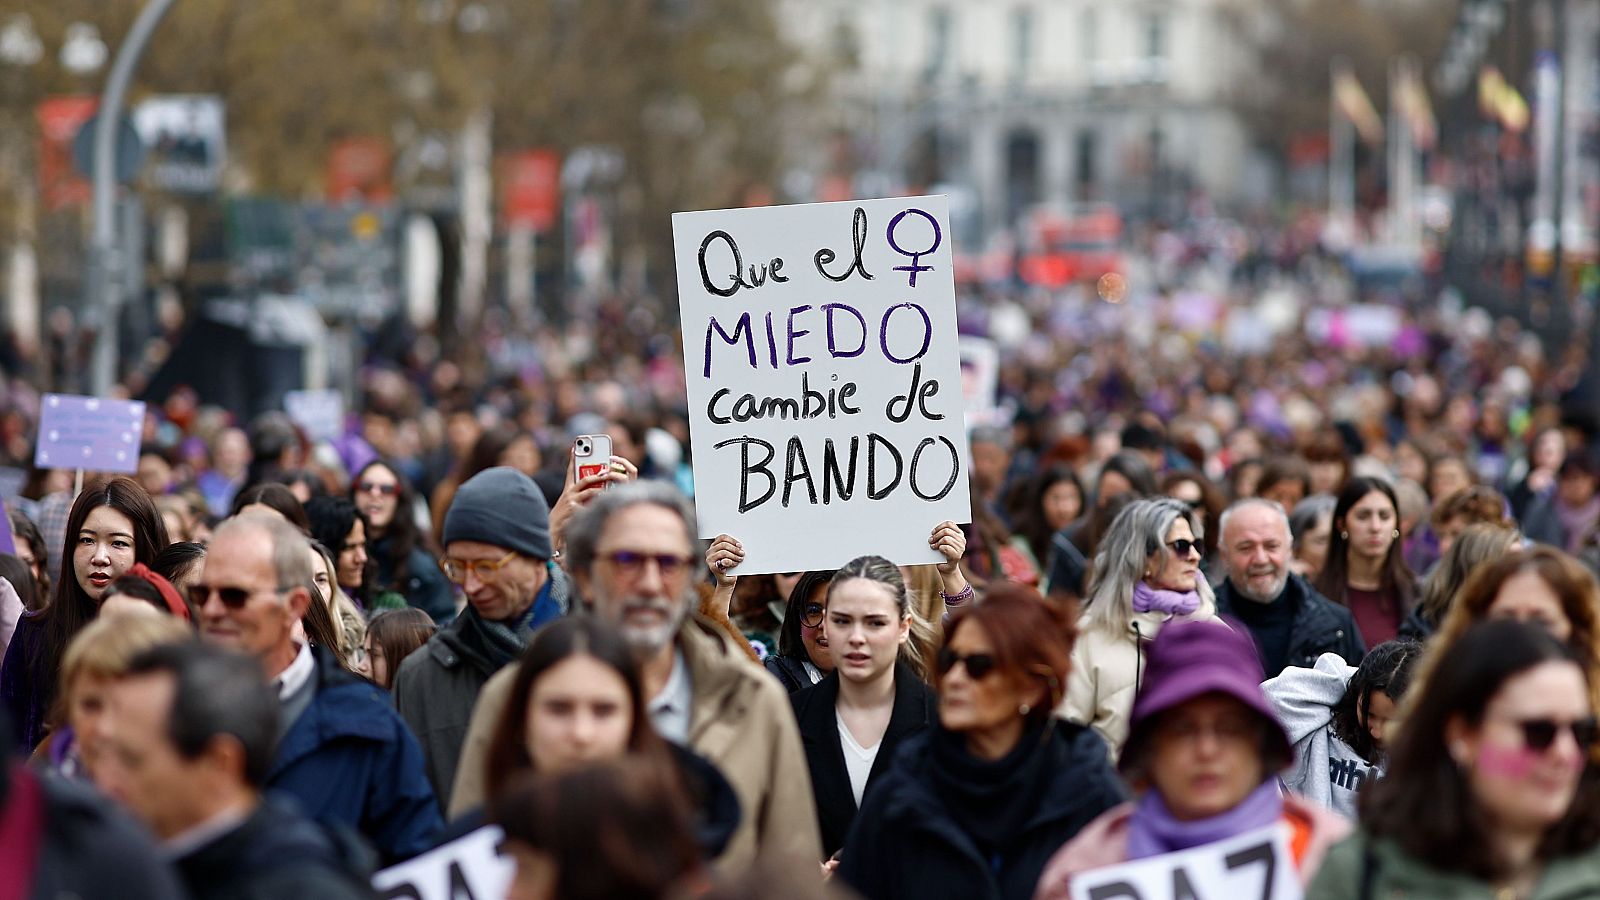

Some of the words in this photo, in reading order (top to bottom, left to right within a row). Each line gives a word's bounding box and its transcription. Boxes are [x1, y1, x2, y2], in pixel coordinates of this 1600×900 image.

[698, 230, 789, 297] Que
[814, 206, 876, 282] el
[703, 302, 932, 379] MIEDO
[707, 371, 862, 424] cambie
[886, 362, 946, 423] de
[713, 432, 960, 514] BANDO
